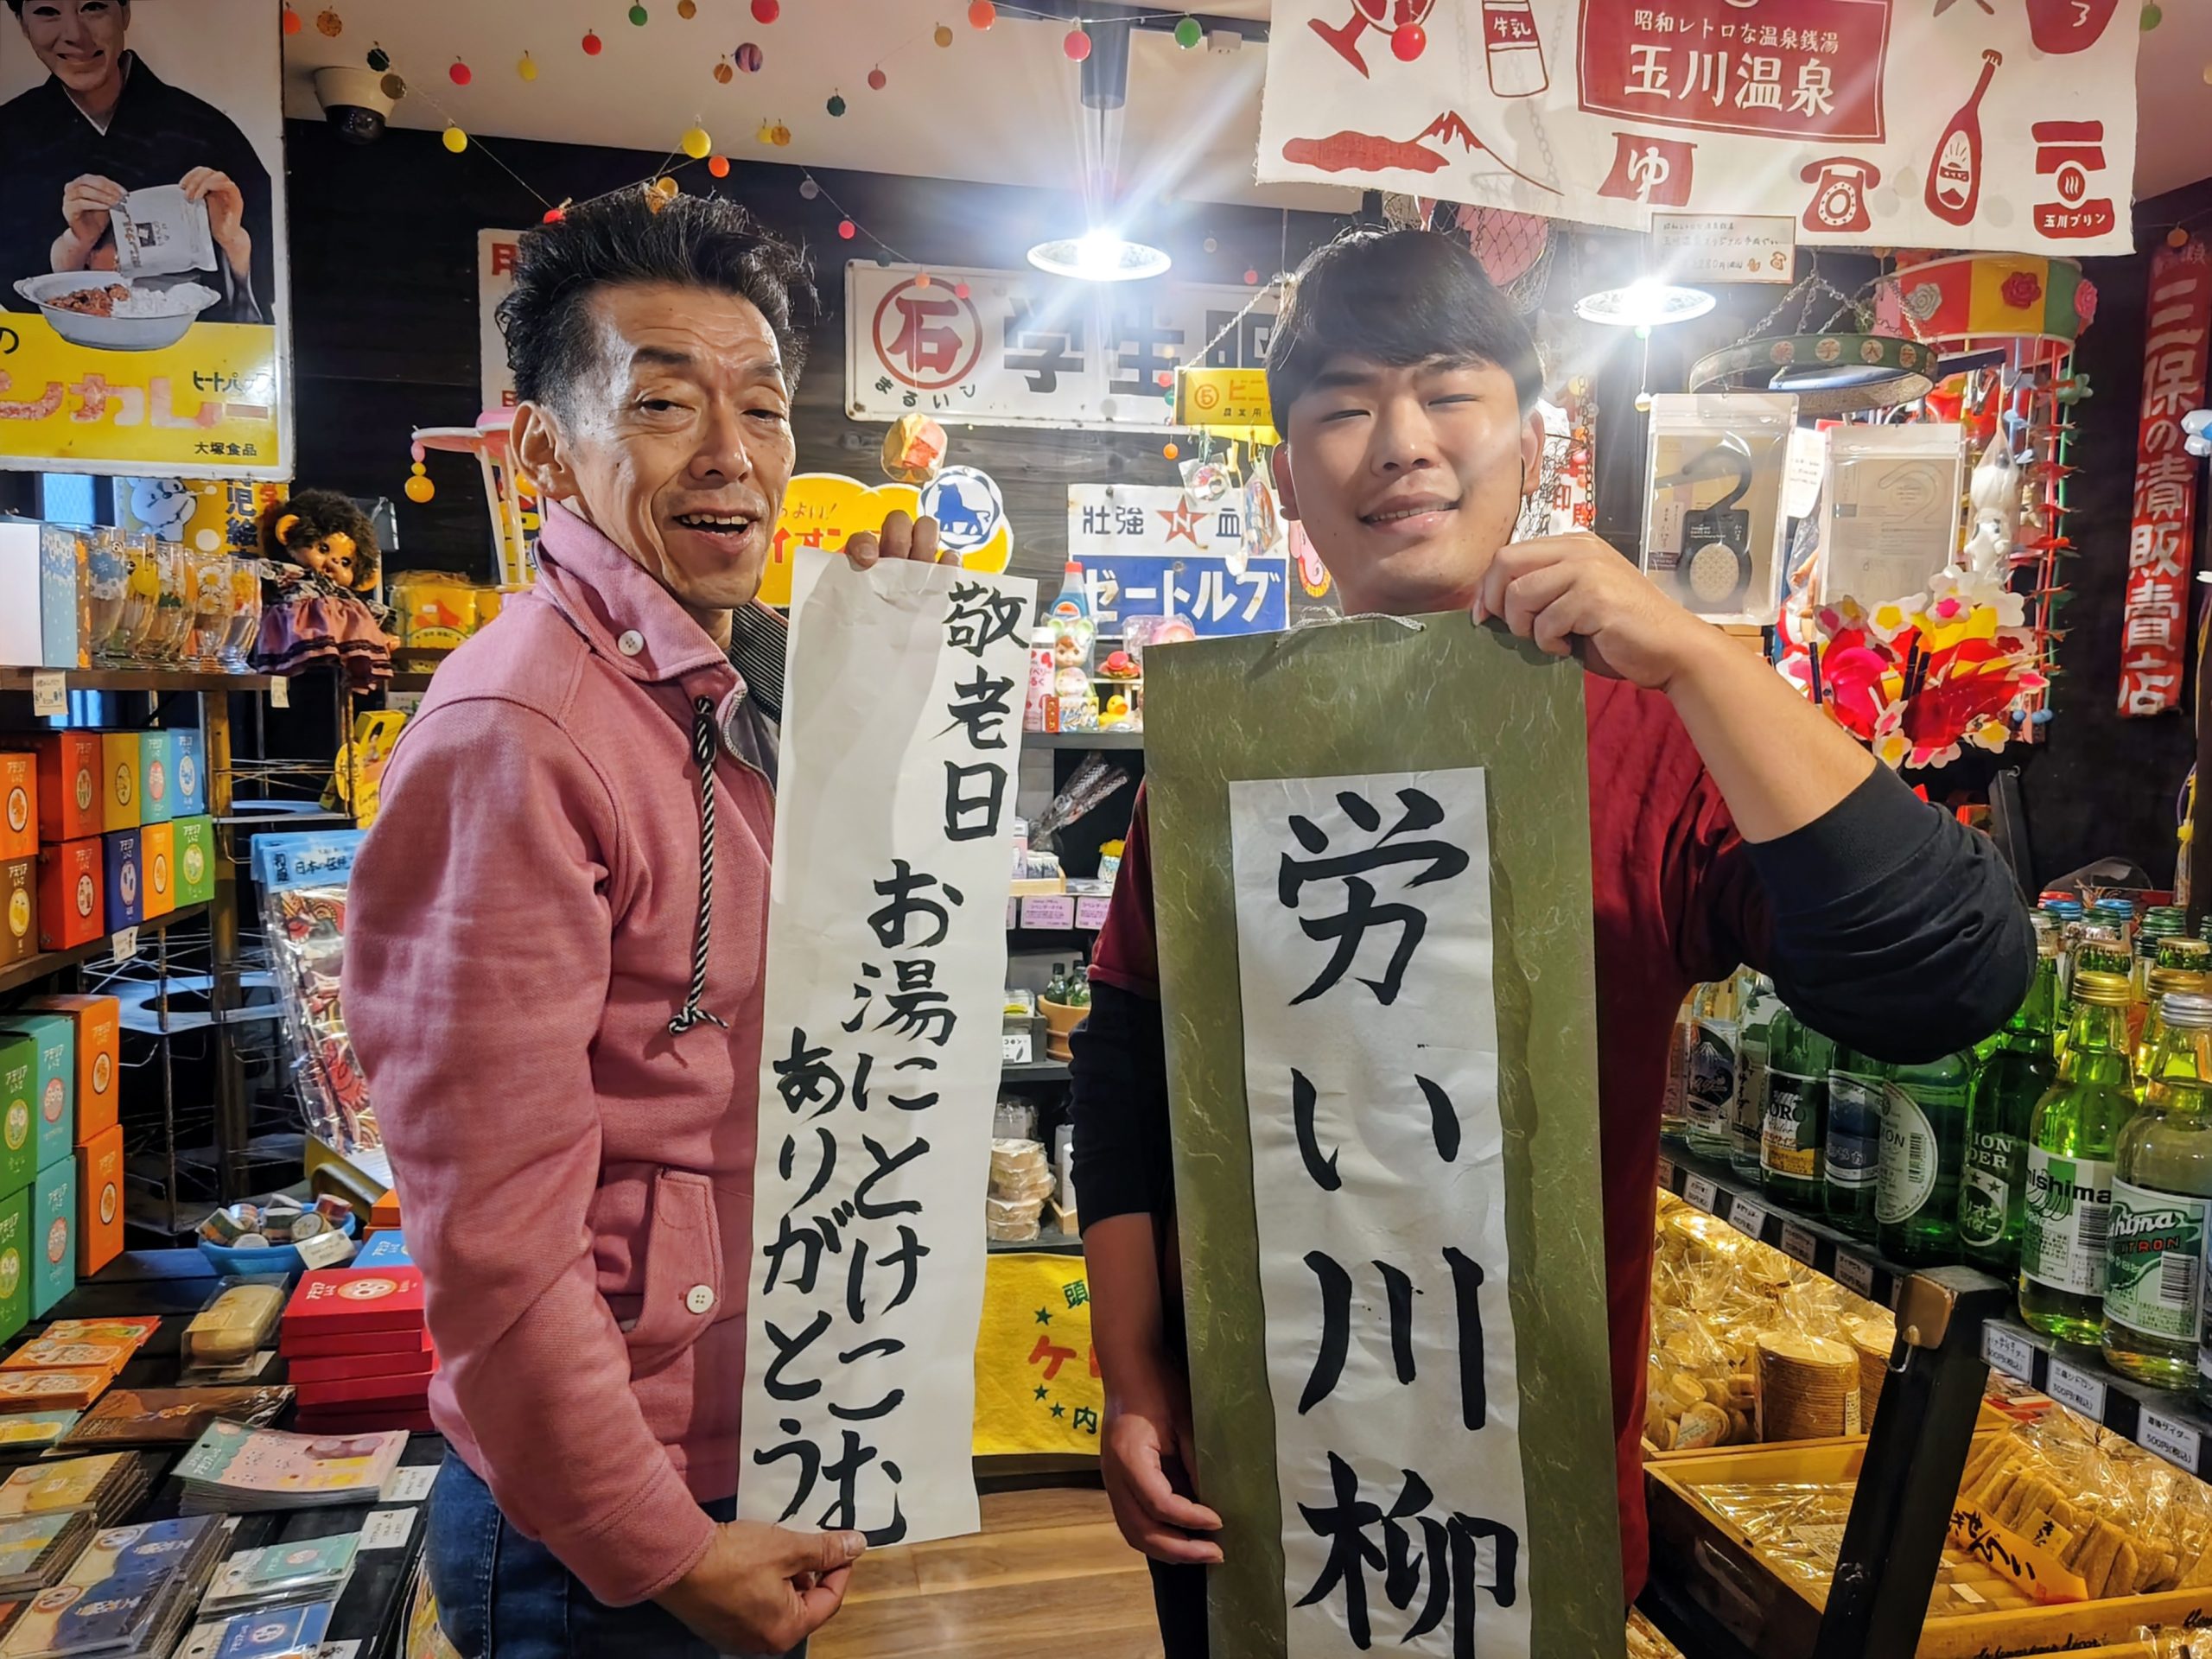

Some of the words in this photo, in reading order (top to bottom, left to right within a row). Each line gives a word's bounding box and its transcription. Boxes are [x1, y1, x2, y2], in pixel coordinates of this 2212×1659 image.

[1493, 16, 1532, 39] 牛乳
[1634, 9, 1839, 54] 昭和レトロな温泉銭湯
[1624, 42, 1835, 118] 玉川温泉
[1627, 146, 1670, 202] ゆ
[2043, 213, 2106, 229] 玉川プリン
[887, 296, 963, 375] 石
[194, 442, 258, 457] 大塚食品
[1086, 568, 1281, 623] ゼートルブ
[929, 582, 1031, 842] 敬老日
[817, 858, 965, 1548] お湯にとけこむ
[1279, 787, 1519, 1659] 労い川柳
[753, 1026, 856, 1524] ありがとう
[1062, 1279, 1090, 1309] 頭
[1072, 1406, 1097, 1434] 内
